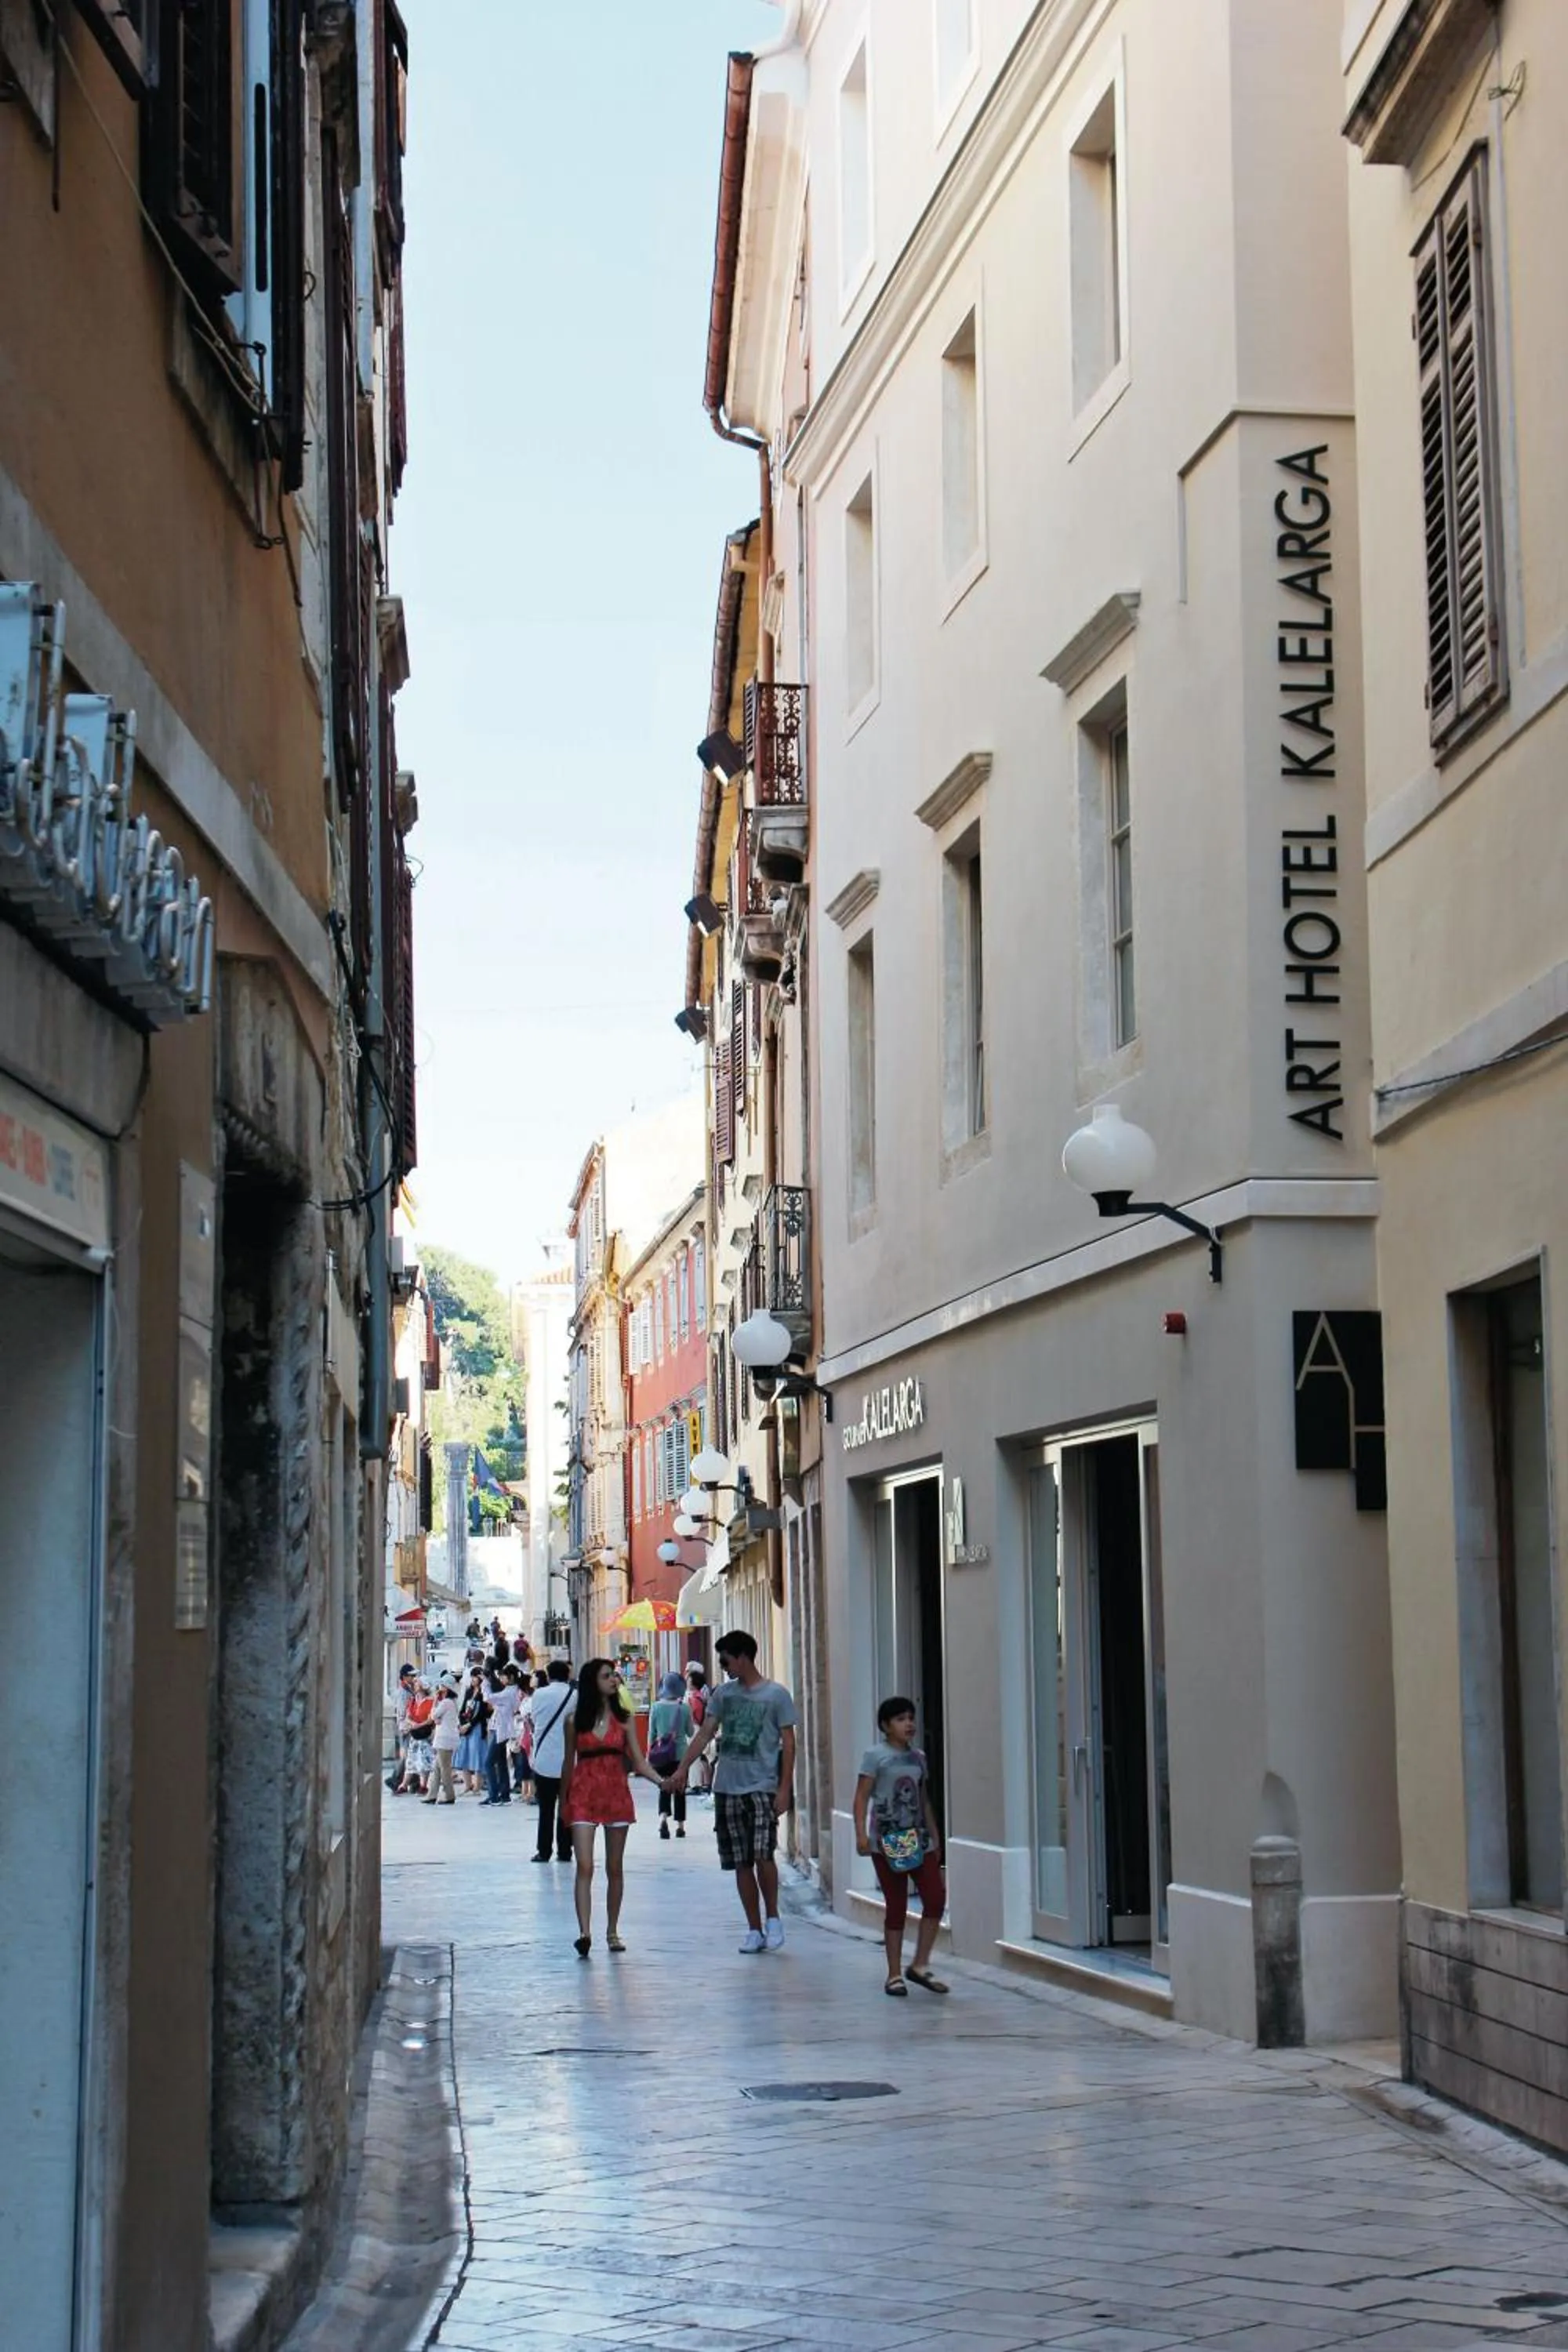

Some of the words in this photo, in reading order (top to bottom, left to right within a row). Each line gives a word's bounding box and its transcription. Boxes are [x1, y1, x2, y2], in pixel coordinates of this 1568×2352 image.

[1274, 444, 1336, 779] KALELARGA
[1282, 815, 1341, 1007] HOTEL
[1285, 1028, 1344, 1143] ART
[862, 1376, 924, 1441] KALELARGA
